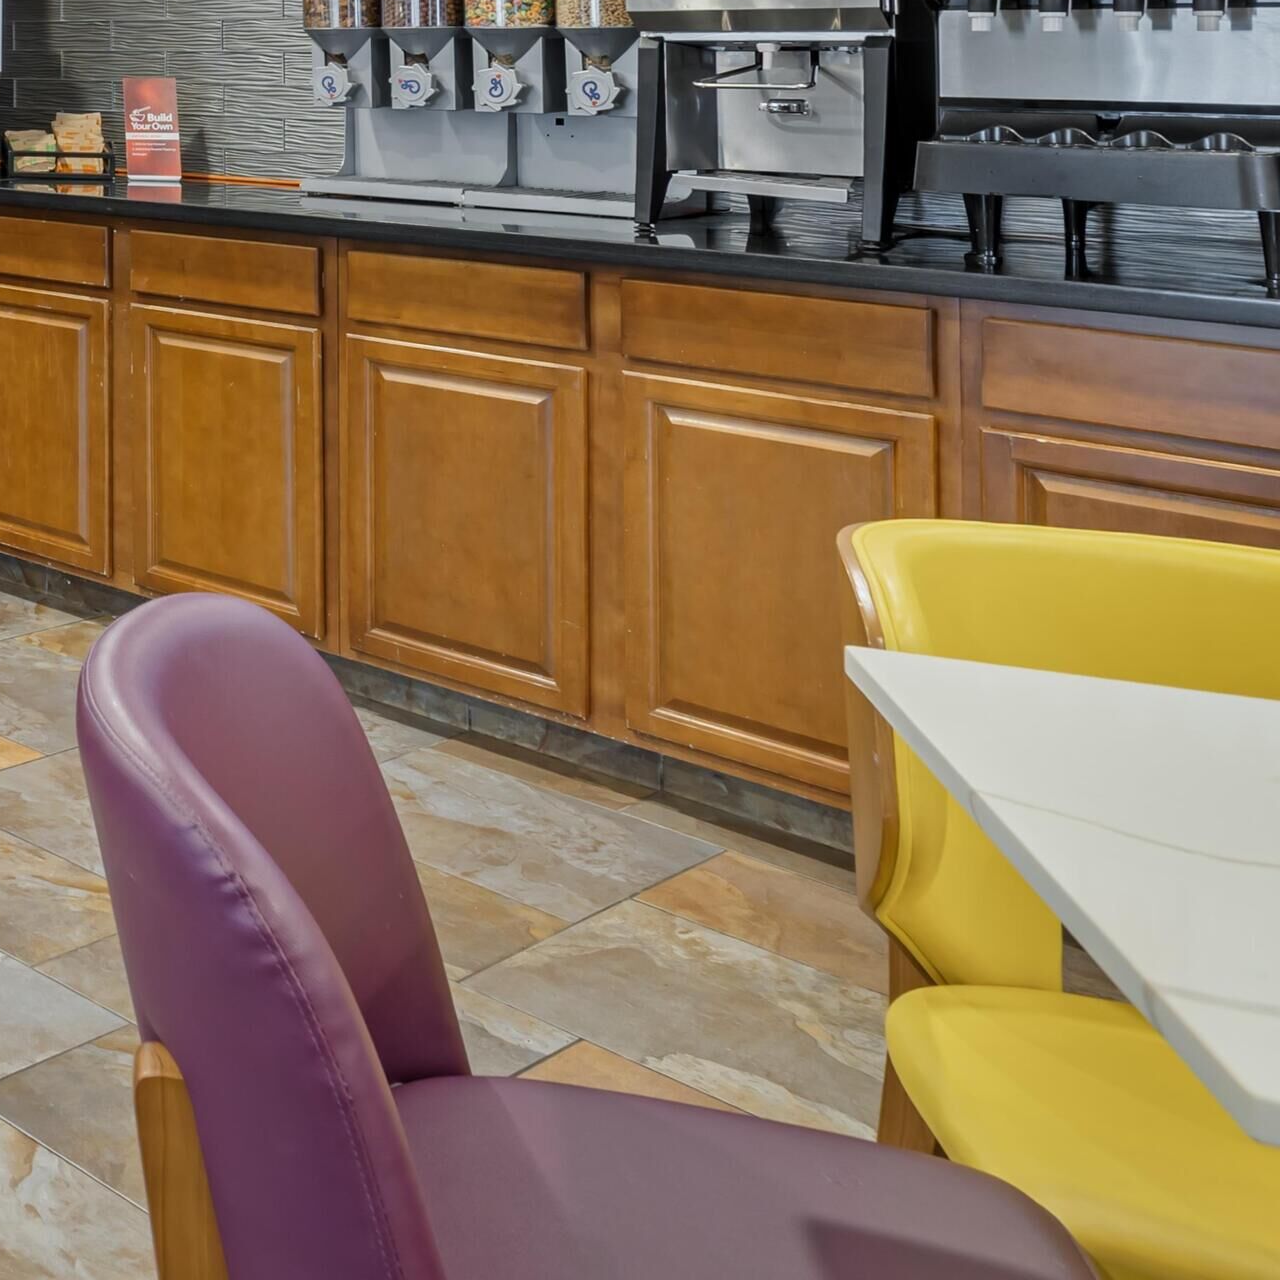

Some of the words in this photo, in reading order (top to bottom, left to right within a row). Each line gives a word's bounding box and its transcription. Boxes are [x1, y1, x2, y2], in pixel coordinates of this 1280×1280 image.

[147, 112, 173, 122] Build
[131, 122, 151, 130] Your
[151, 122, 174, 130] Own
